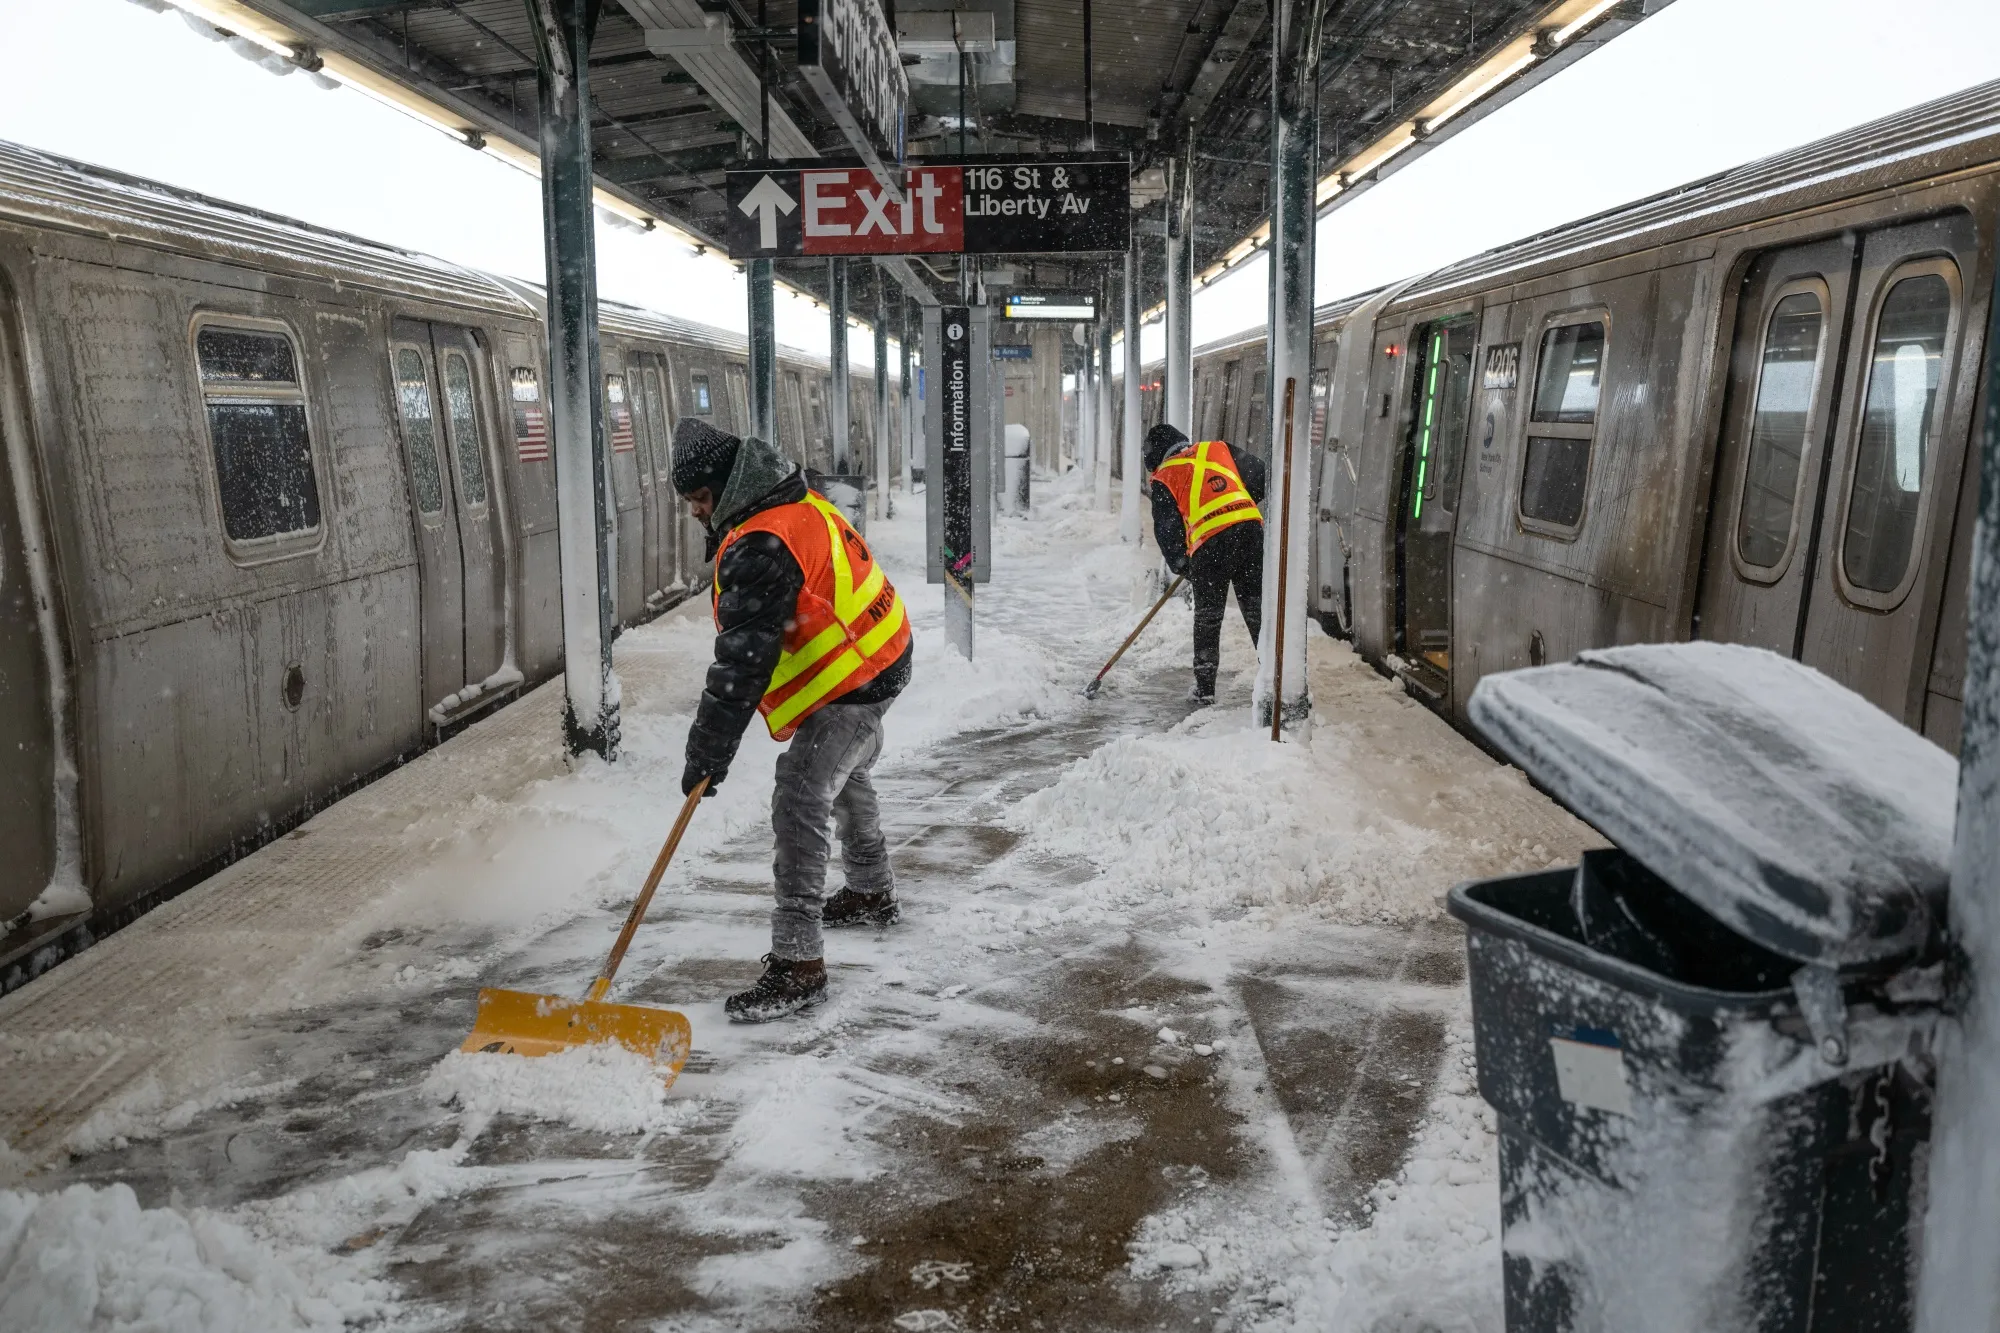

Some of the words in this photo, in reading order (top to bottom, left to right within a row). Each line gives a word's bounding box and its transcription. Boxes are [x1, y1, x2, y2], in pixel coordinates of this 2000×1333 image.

[965, 167, 1002, 190] 116
[1013, 167, 1040, 191] St
[1051, 166, 1070, 189] &
[803, 170, 944, 237] Exit
[965, 194, 1050, 219] Liberty
[1061, 192, 1090, 215] Av
[1486, 347, 1518, 383] 4206
[949, 360, 964, 452] Information
[1225, 500, 1254, 513] Transit
[867, 593, 891, 622] NYC
